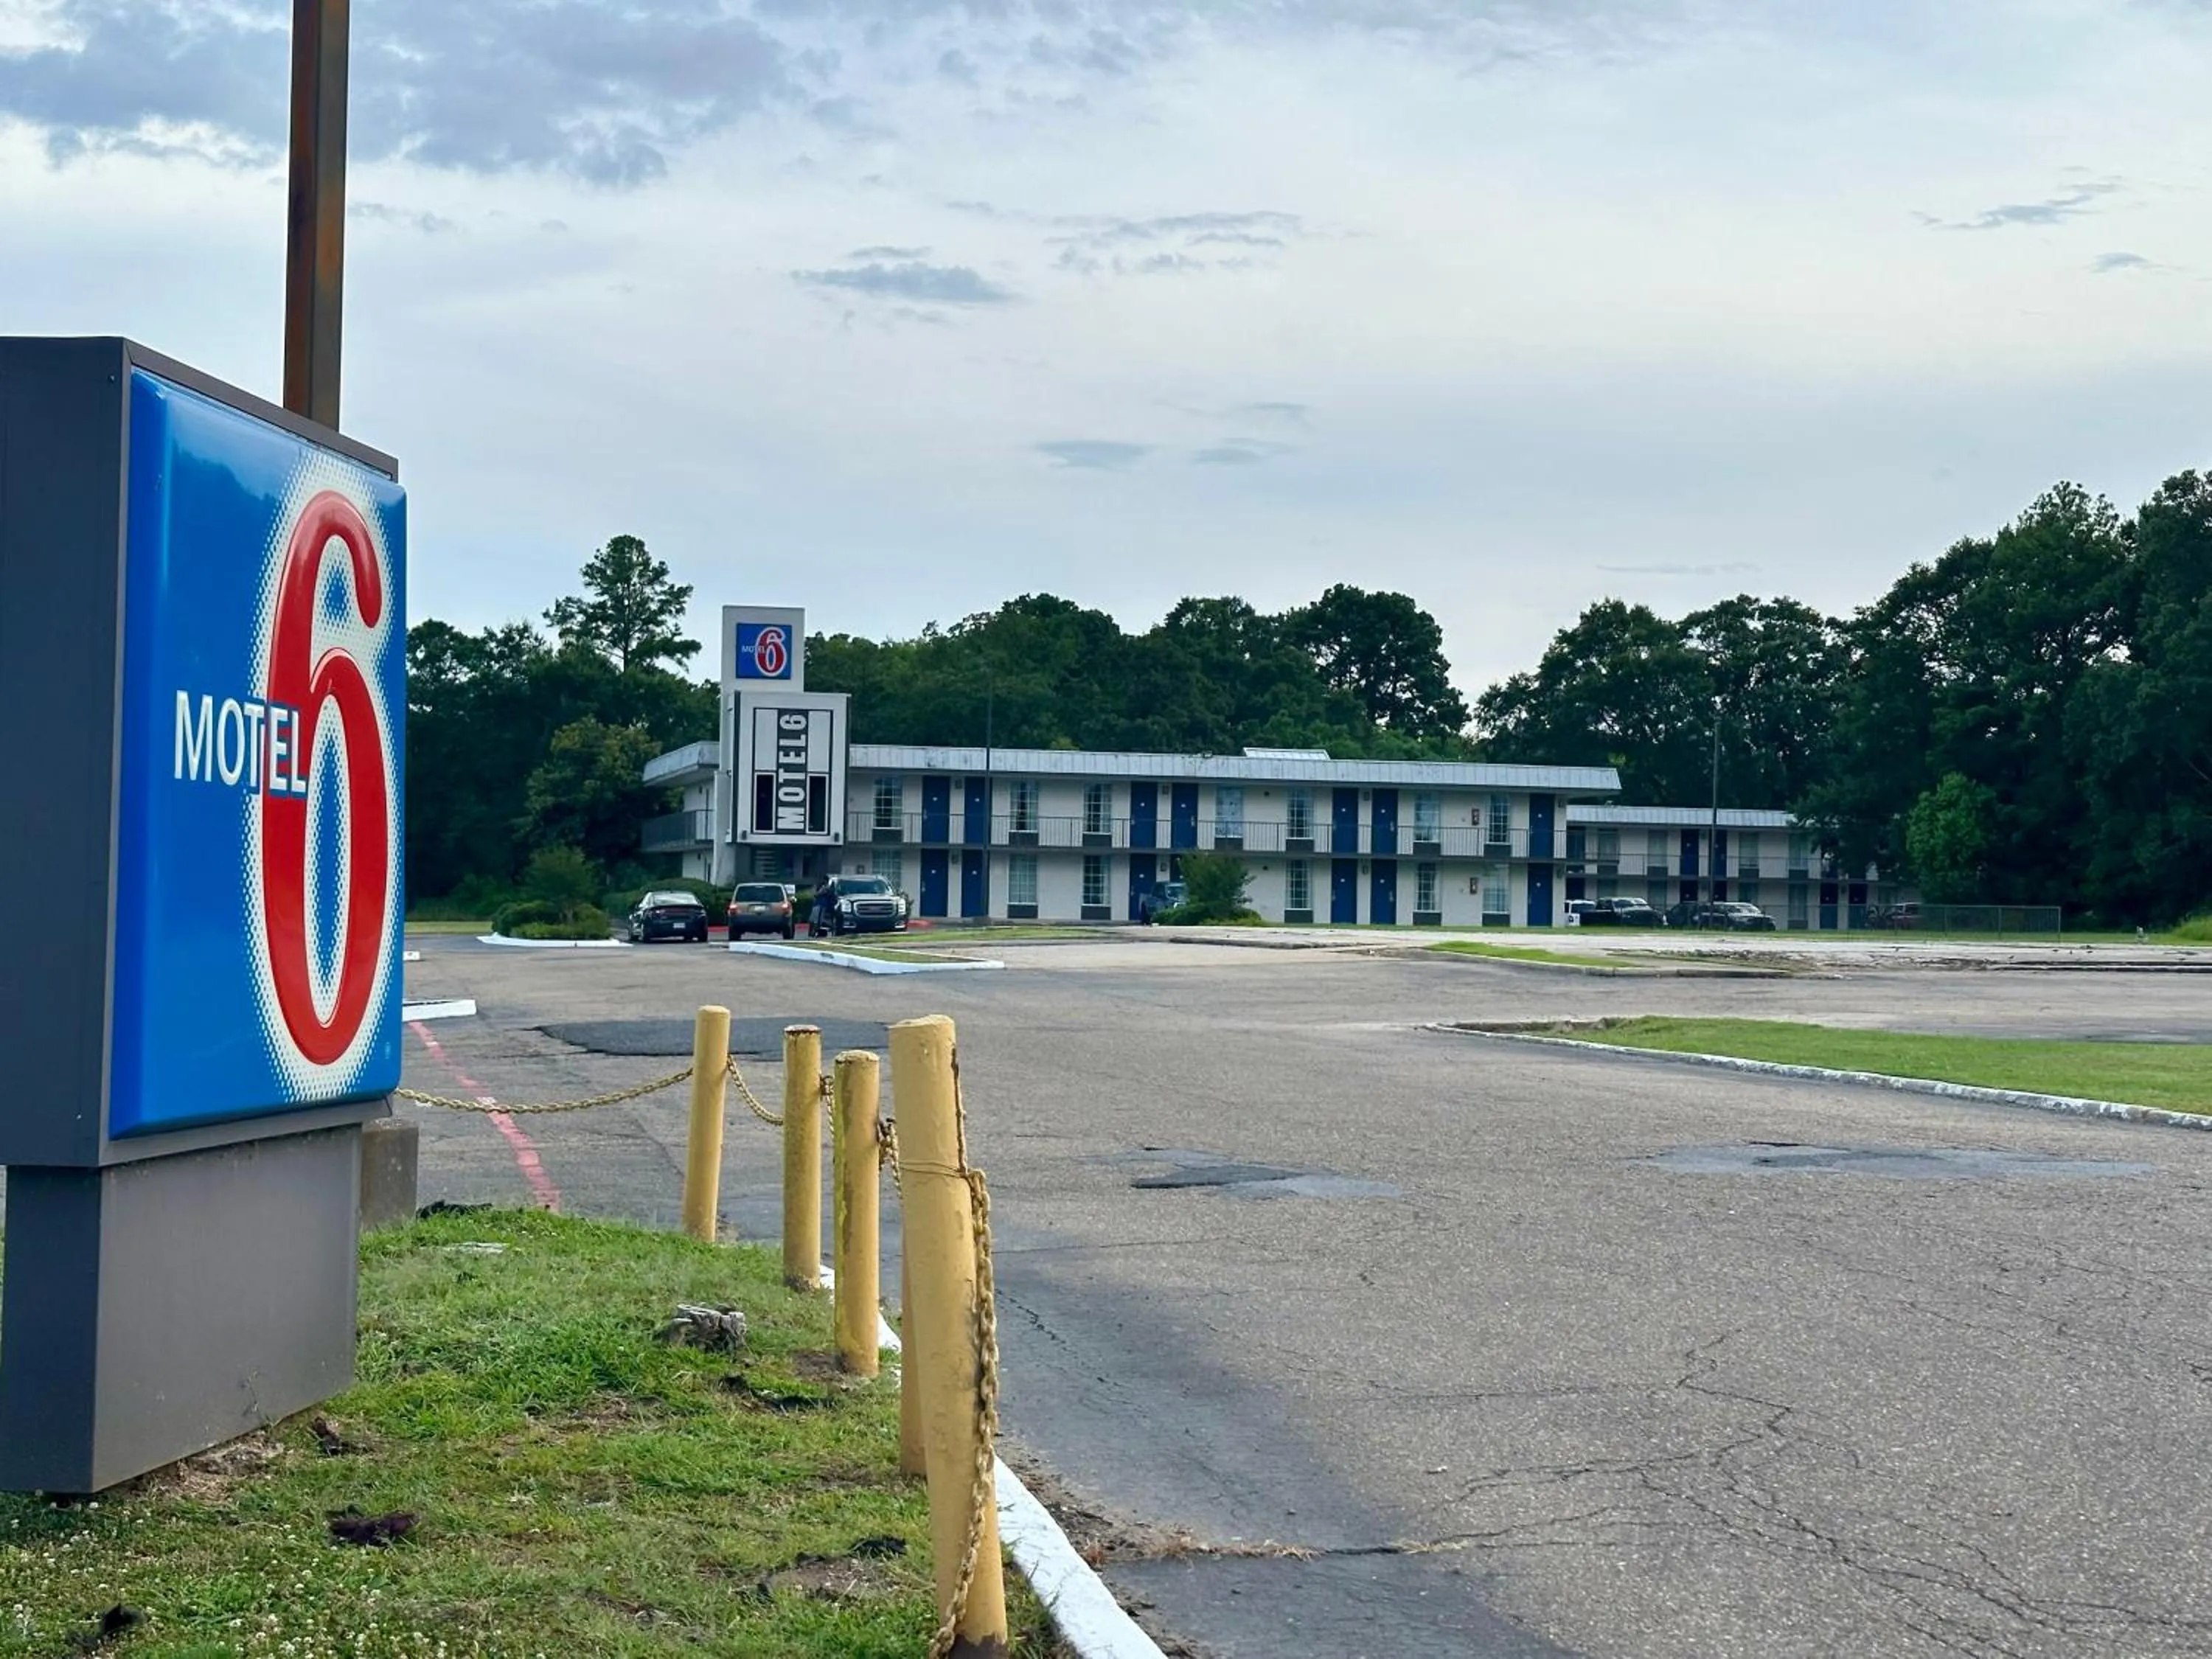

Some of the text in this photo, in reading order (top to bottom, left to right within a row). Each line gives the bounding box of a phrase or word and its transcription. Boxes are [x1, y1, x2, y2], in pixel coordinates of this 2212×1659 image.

[174, 490, 388, 1066] MOTEL 6
[756, 627, 786, 675] 6
